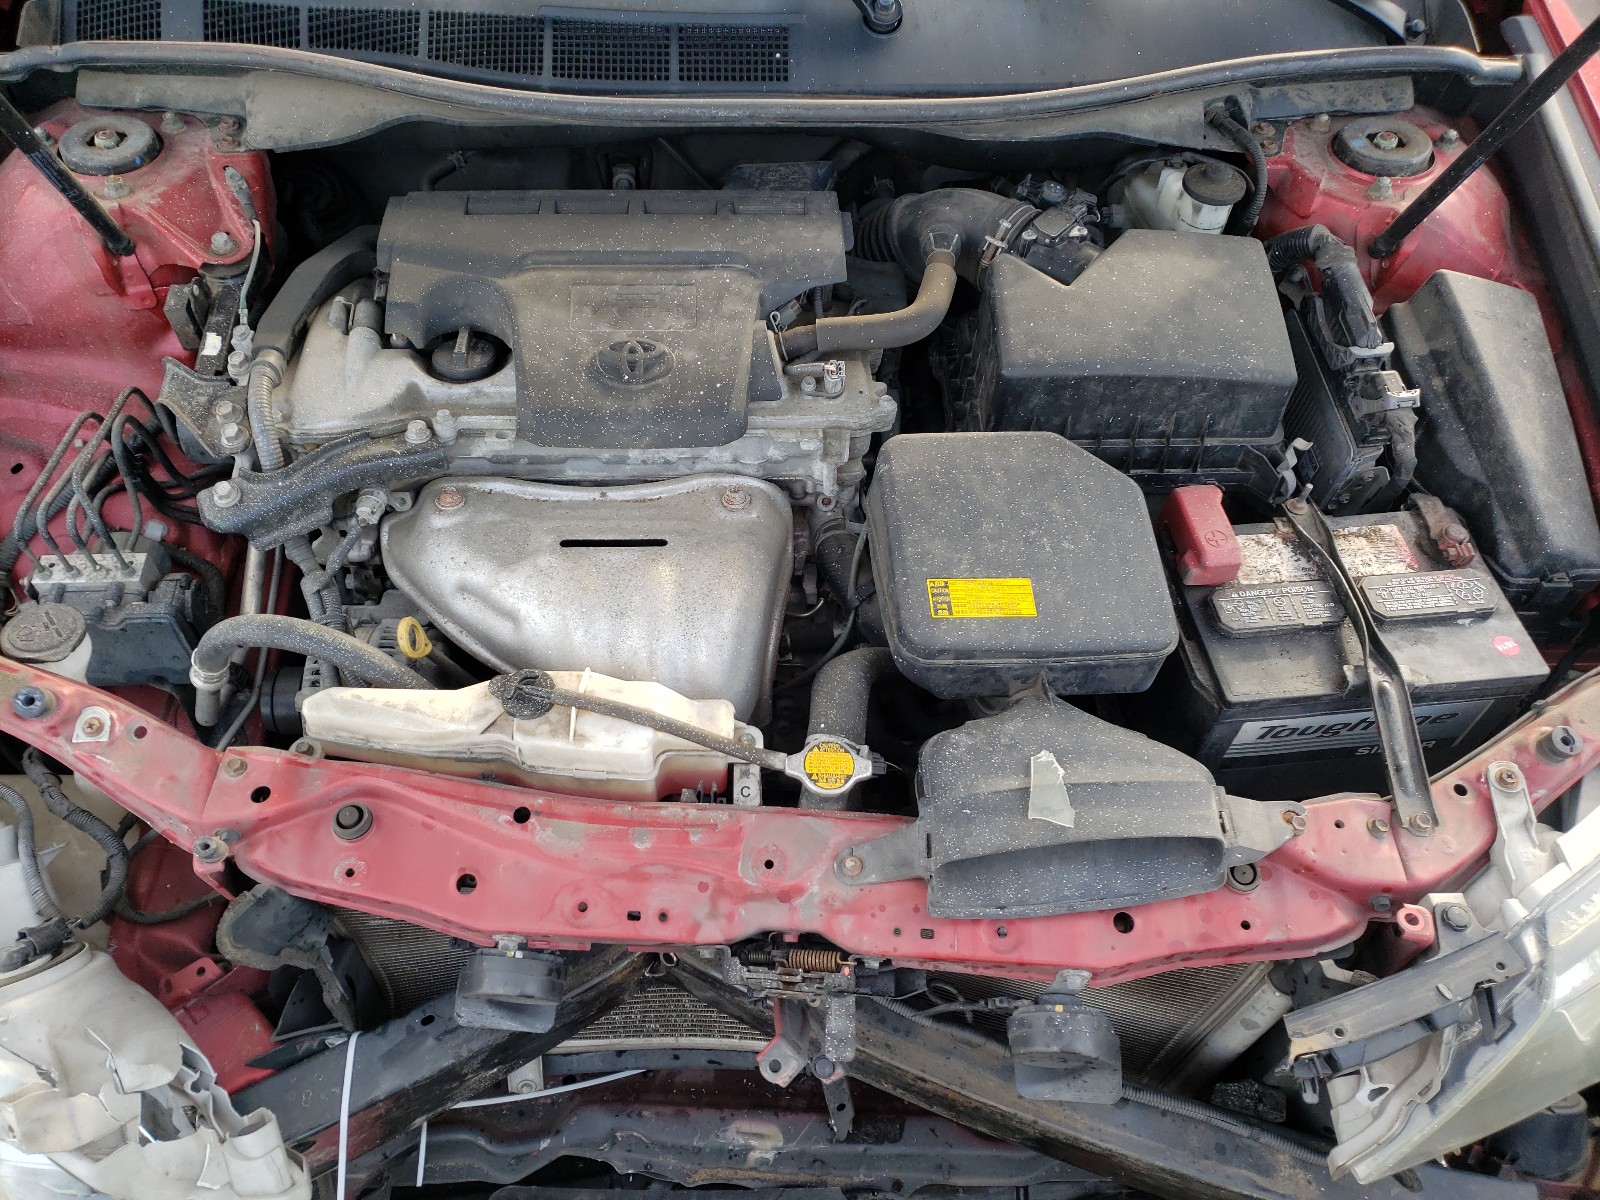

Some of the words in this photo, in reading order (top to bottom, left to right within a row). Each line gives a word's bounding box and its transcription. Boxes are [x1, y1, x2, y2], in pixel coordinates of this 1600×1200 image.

[1239, 588, 1274, 597] DANGER
[1281, 585, 1314, 593] POISON
[1256, 711, 1462, 739] Toughne
